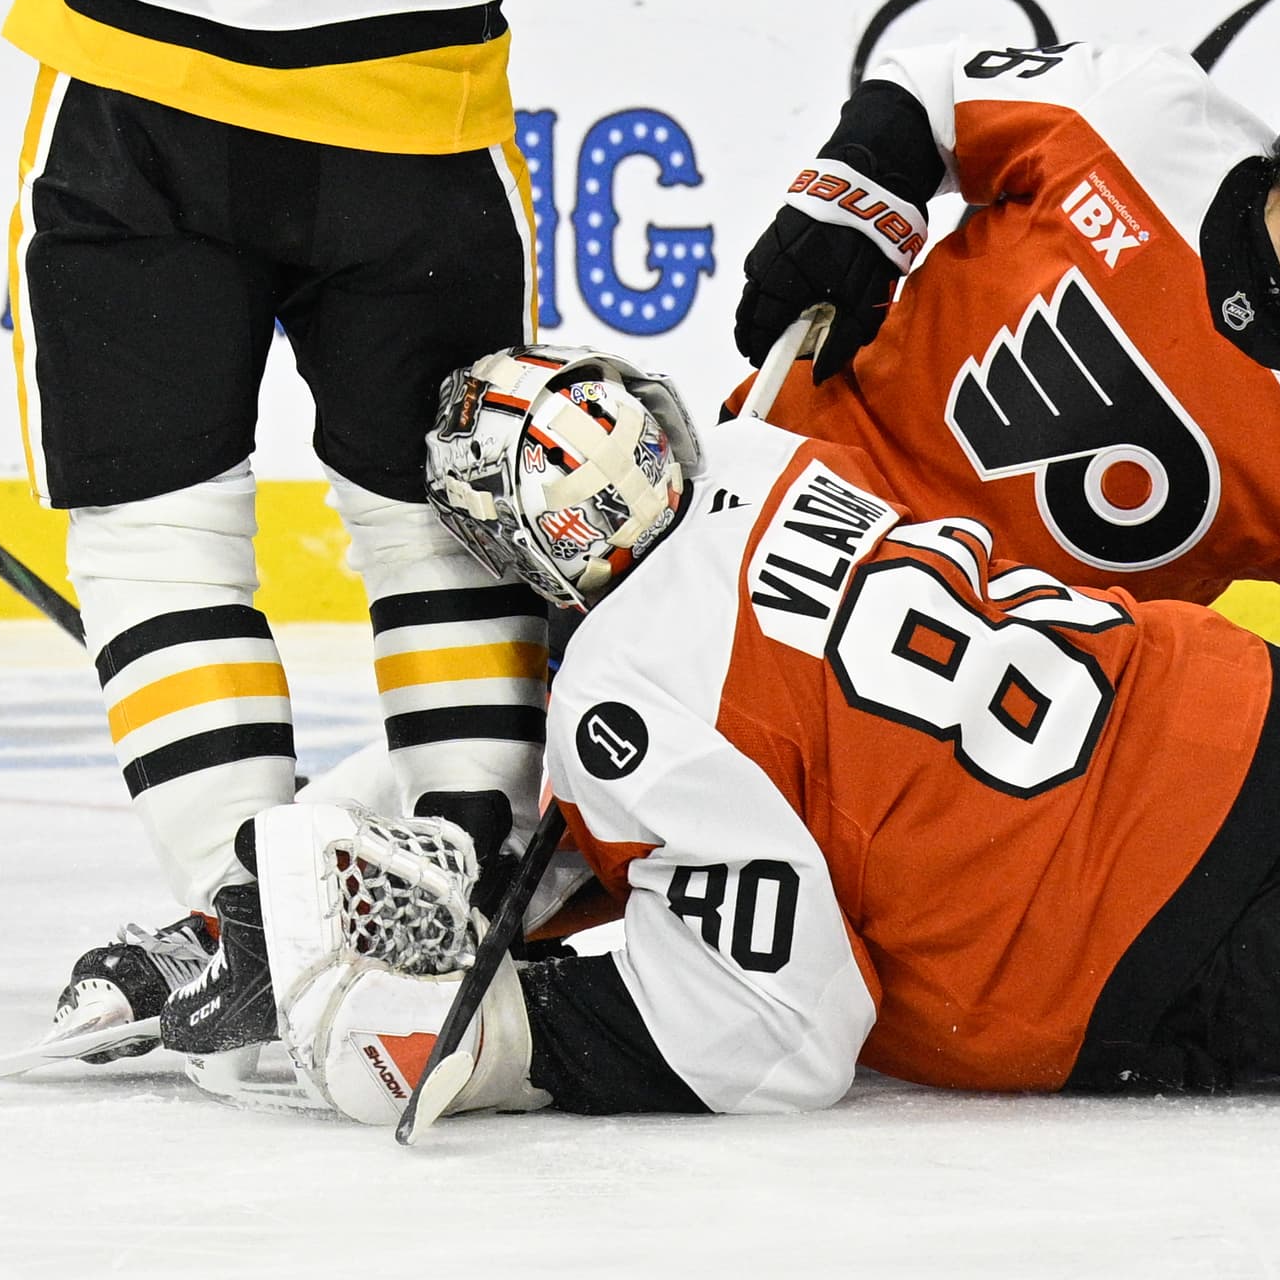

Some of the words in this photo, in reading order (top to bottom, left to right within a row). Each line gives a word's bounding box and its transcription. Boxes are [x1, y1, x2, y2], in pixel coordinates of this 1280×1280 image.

[1060, 179, 1141, 270] IBX
[1089, 171, 1141, 232] Independence
[523, 443, 546, 473] M
[587, 714, 637, 770] 1
[668, 859, 800, 974] 80
[189, 995, 222, 1027] CCM
[362, 1043, 408, 1100] SHADOW
